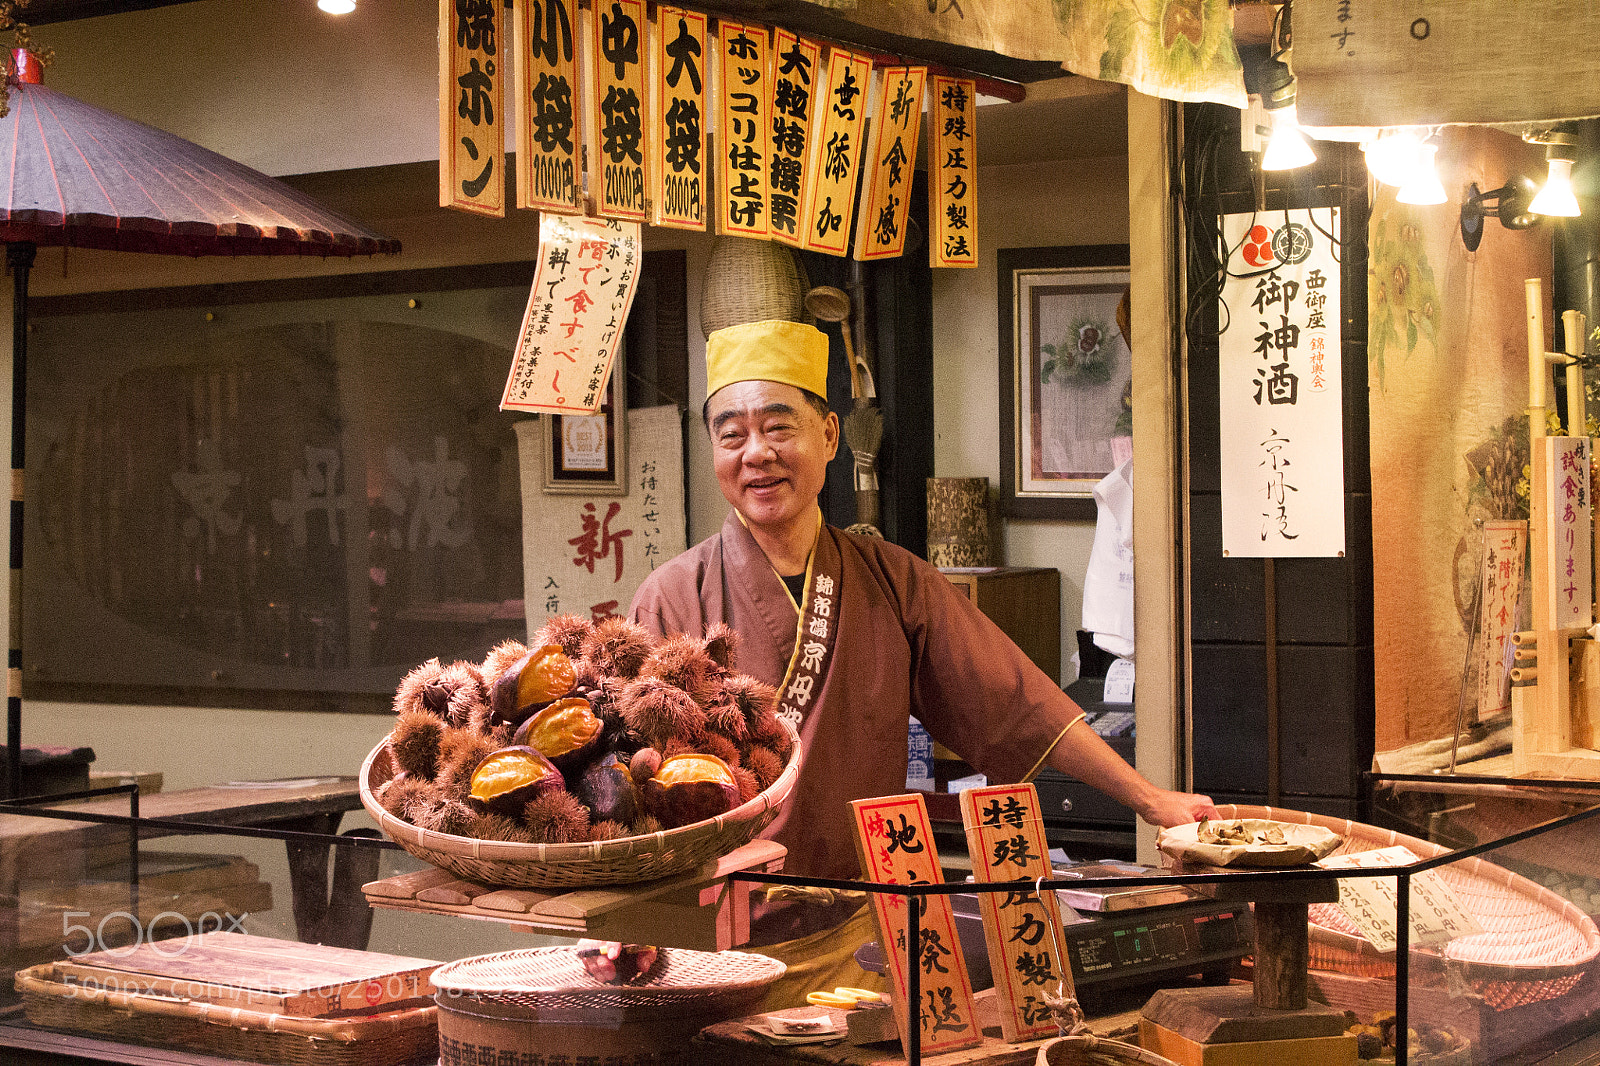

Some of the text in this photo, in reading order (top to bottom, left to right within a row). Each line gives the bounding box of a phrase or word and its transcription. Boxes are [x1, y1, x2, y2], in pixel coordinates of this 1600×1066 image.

[532, 0, 574, 155] 小袋
[601, 3, 643, 165] 中袋
[665, 19, 701, 174] 大袋
[727, 33, 764, 228] ホッコリ仕上げ
[770, 45, 812, 235] 大粒特撰栗
[817, 66, 861, 239] 無添加
[533, 154, 574, 204] 1000円
[604, 164, 645, 211] 2000円
[664, 174, 700, 220] 3000円
[874, 79, 915, 246] 新食感
[941, 85, 971, 258] 特殊圧力製法
[1251, 271, 1300, 406] 御神酒
[1560, 450, 1579, 615] 試食あります。
